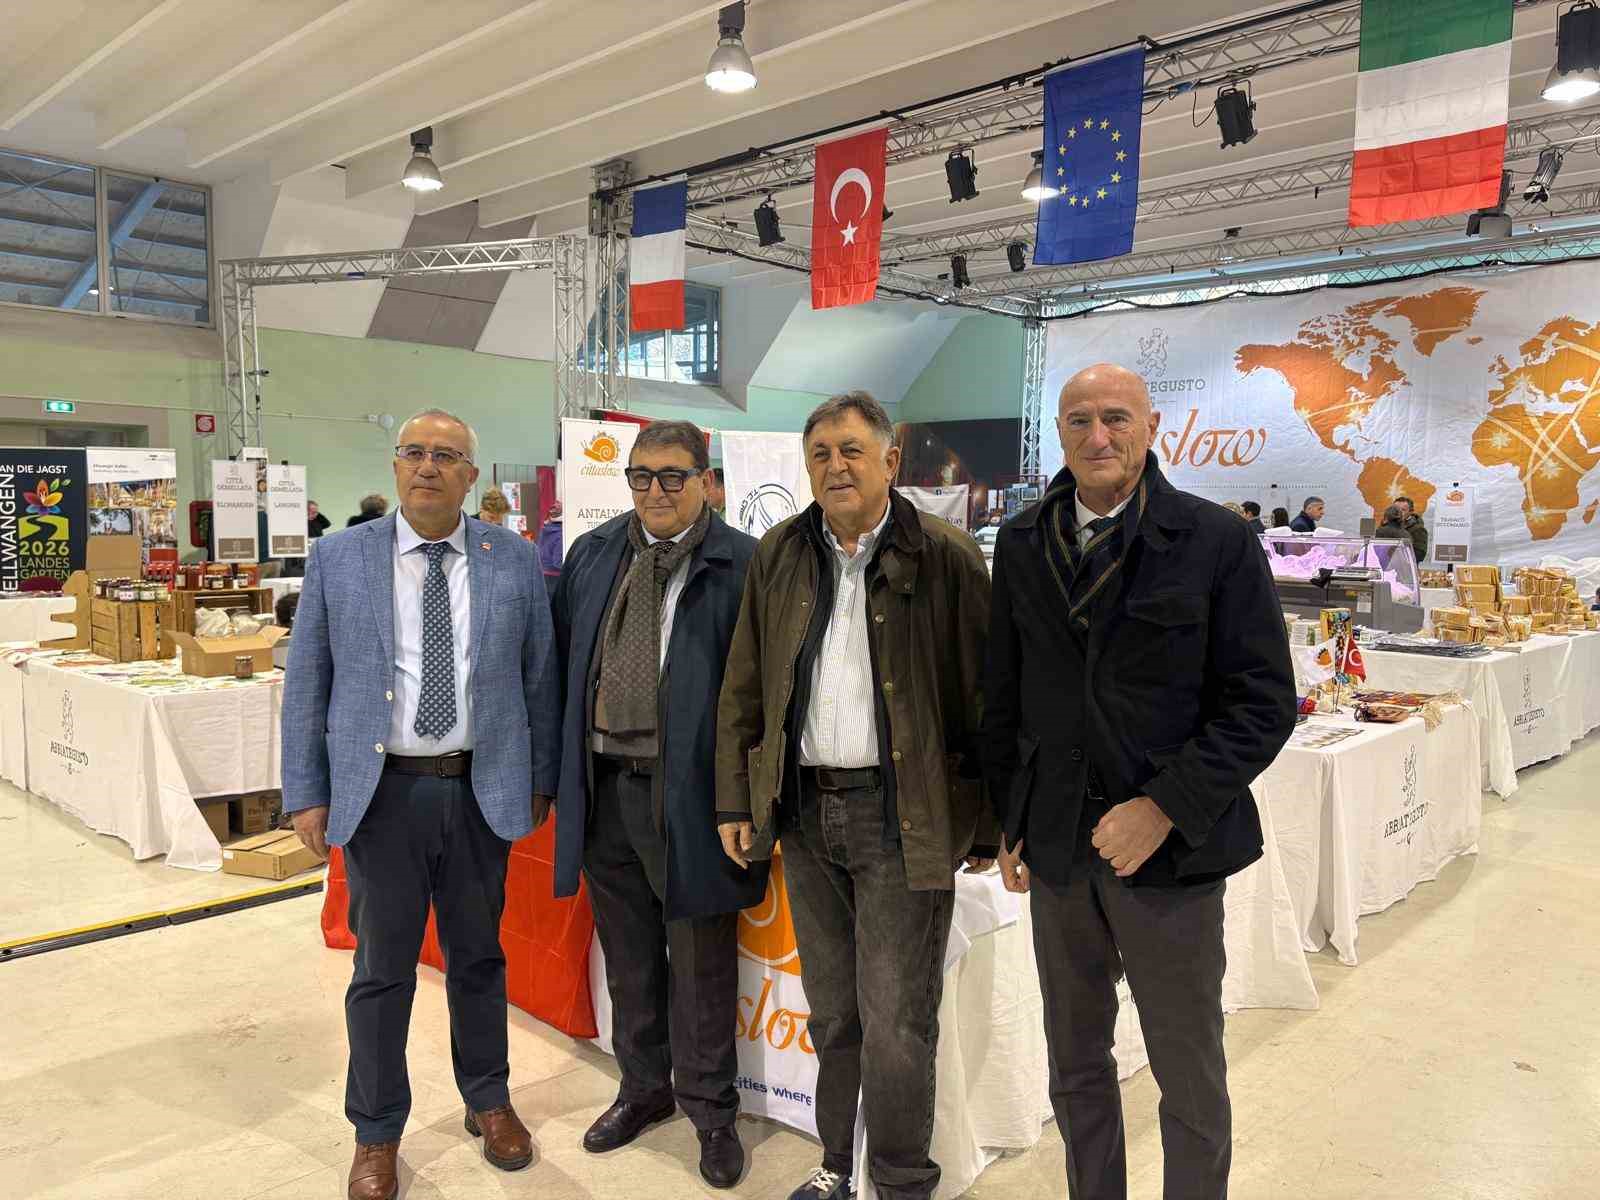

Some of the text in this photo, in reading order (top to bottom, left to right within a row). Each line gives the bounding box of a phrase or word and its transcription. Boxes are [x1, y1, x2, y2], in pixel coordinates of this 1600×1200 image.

[1160, 408, 1267, 467] slow
[17, 464, 34, 474] DIE
[36, 465, 68, 474] JAGST
[0, 473, 18, 590] ELLWANGEN
[19, 541, 70, 556] 2026
[20, 557, 70, 569] LANDES
[773, 1086, 812, 1106] where
